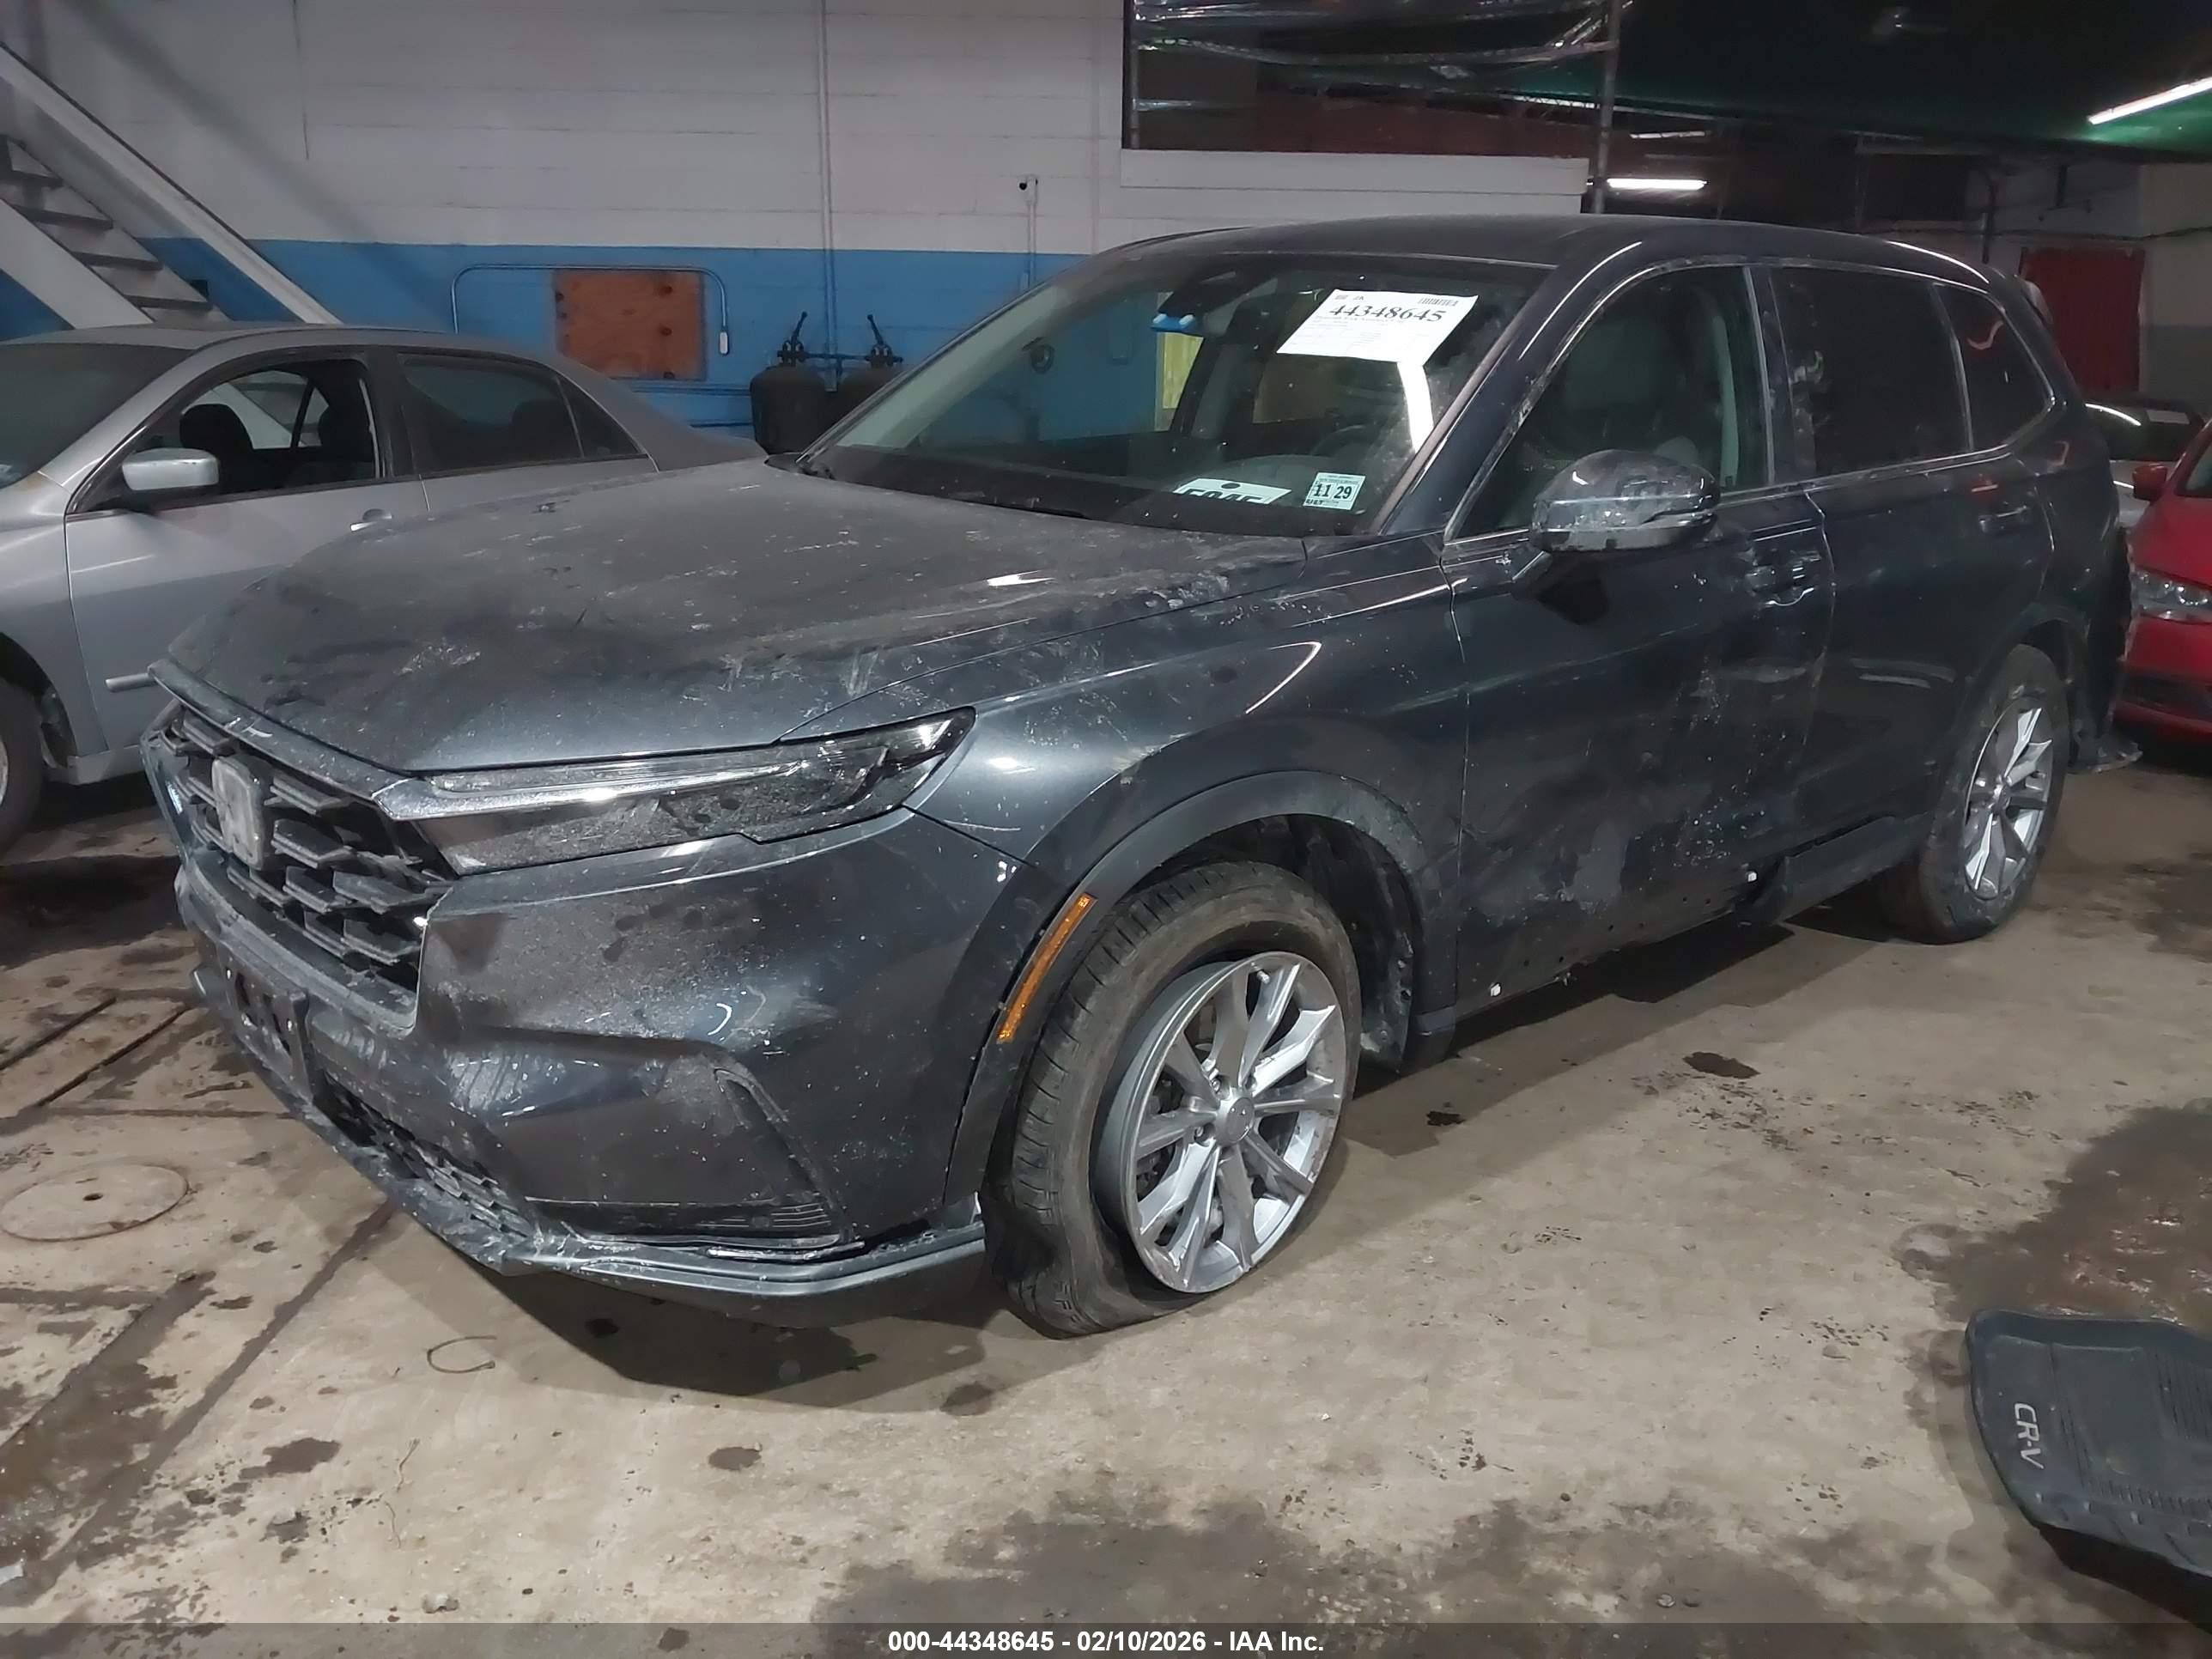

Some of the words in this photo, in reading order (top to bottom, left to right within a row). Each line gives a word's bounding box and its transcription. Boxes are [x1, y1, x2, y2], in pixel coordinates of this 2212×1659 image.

[1329, 304, 1447, 322] 44348645
[1313, 483, 1332, 497] 11
[1334, 485, 1352, 499] 29
[2014, 1402, 2045, 1469] CR-V
